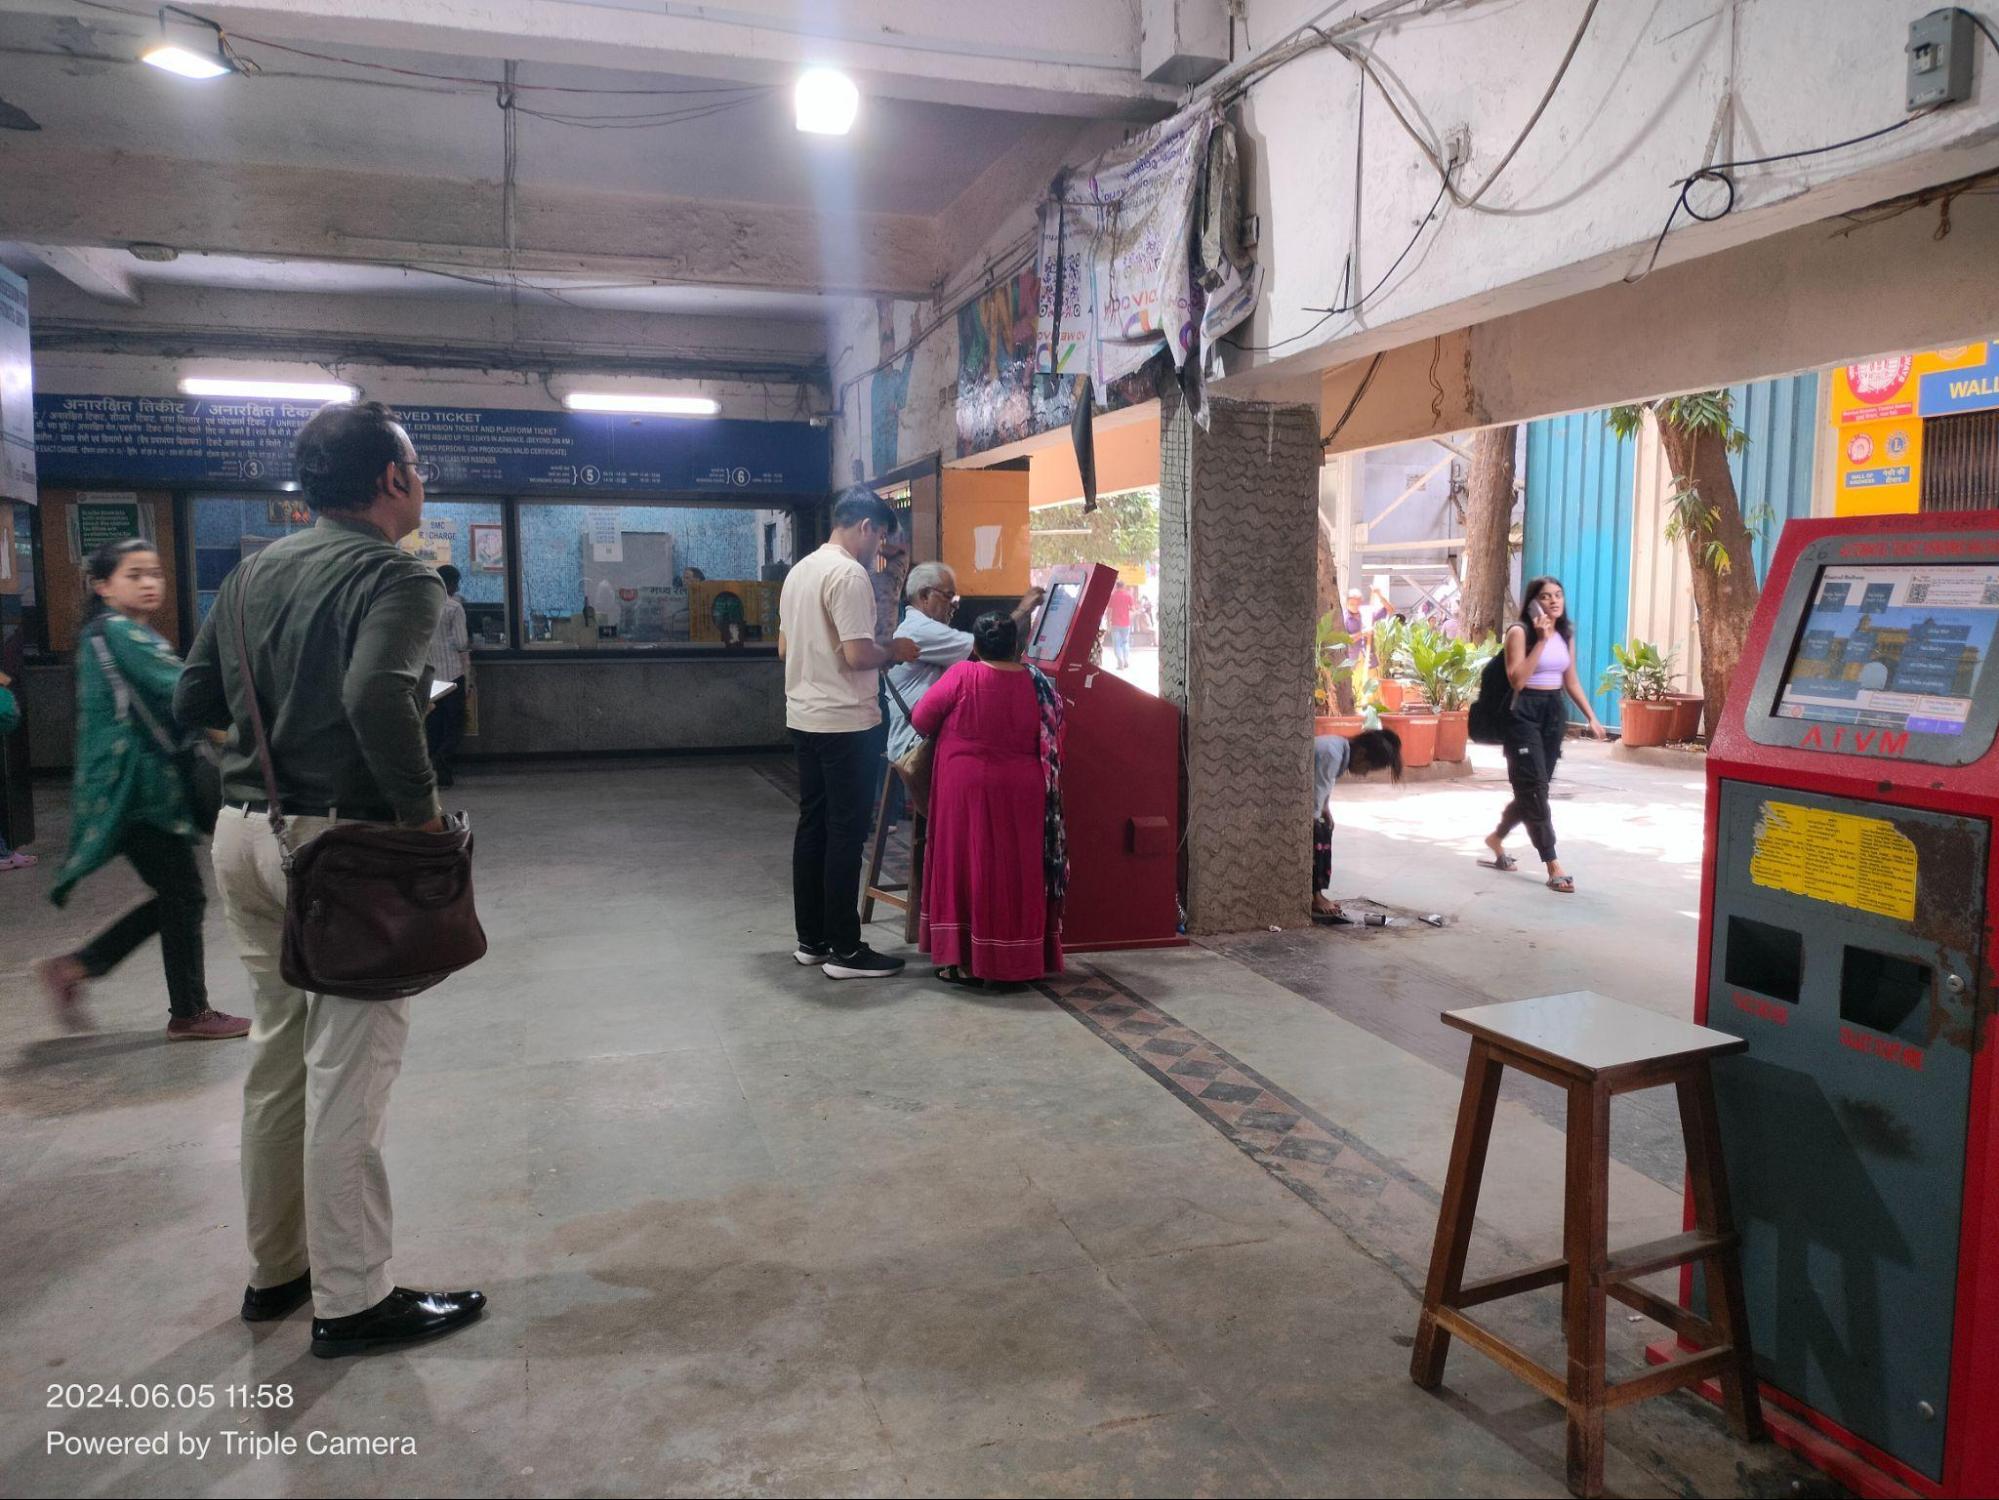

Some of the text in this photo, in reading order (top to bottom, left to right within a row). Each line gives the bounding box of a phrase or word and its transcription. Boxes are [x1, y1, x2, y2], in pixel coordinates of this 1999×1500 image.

[62, 396, 132, 413] अनारक्षित
[139, 398, 185, 415] तिकीट
[209, 402, 275, 417] अनारक्षित
[434, 412, 482, 424] TICKET
[414, 424, 453, 432] EXTENSION
[455, 425, 478, 433] TICKET
[496, 426, 532, 434] PLATFORM
[534, 427, 557, 435] TICKET
[249, 462, 257, 476] 3
[586, 469, 594, 481] 5
[738, 470, 745, 483] 6
[429, 532, 456, 540] CHARGE
